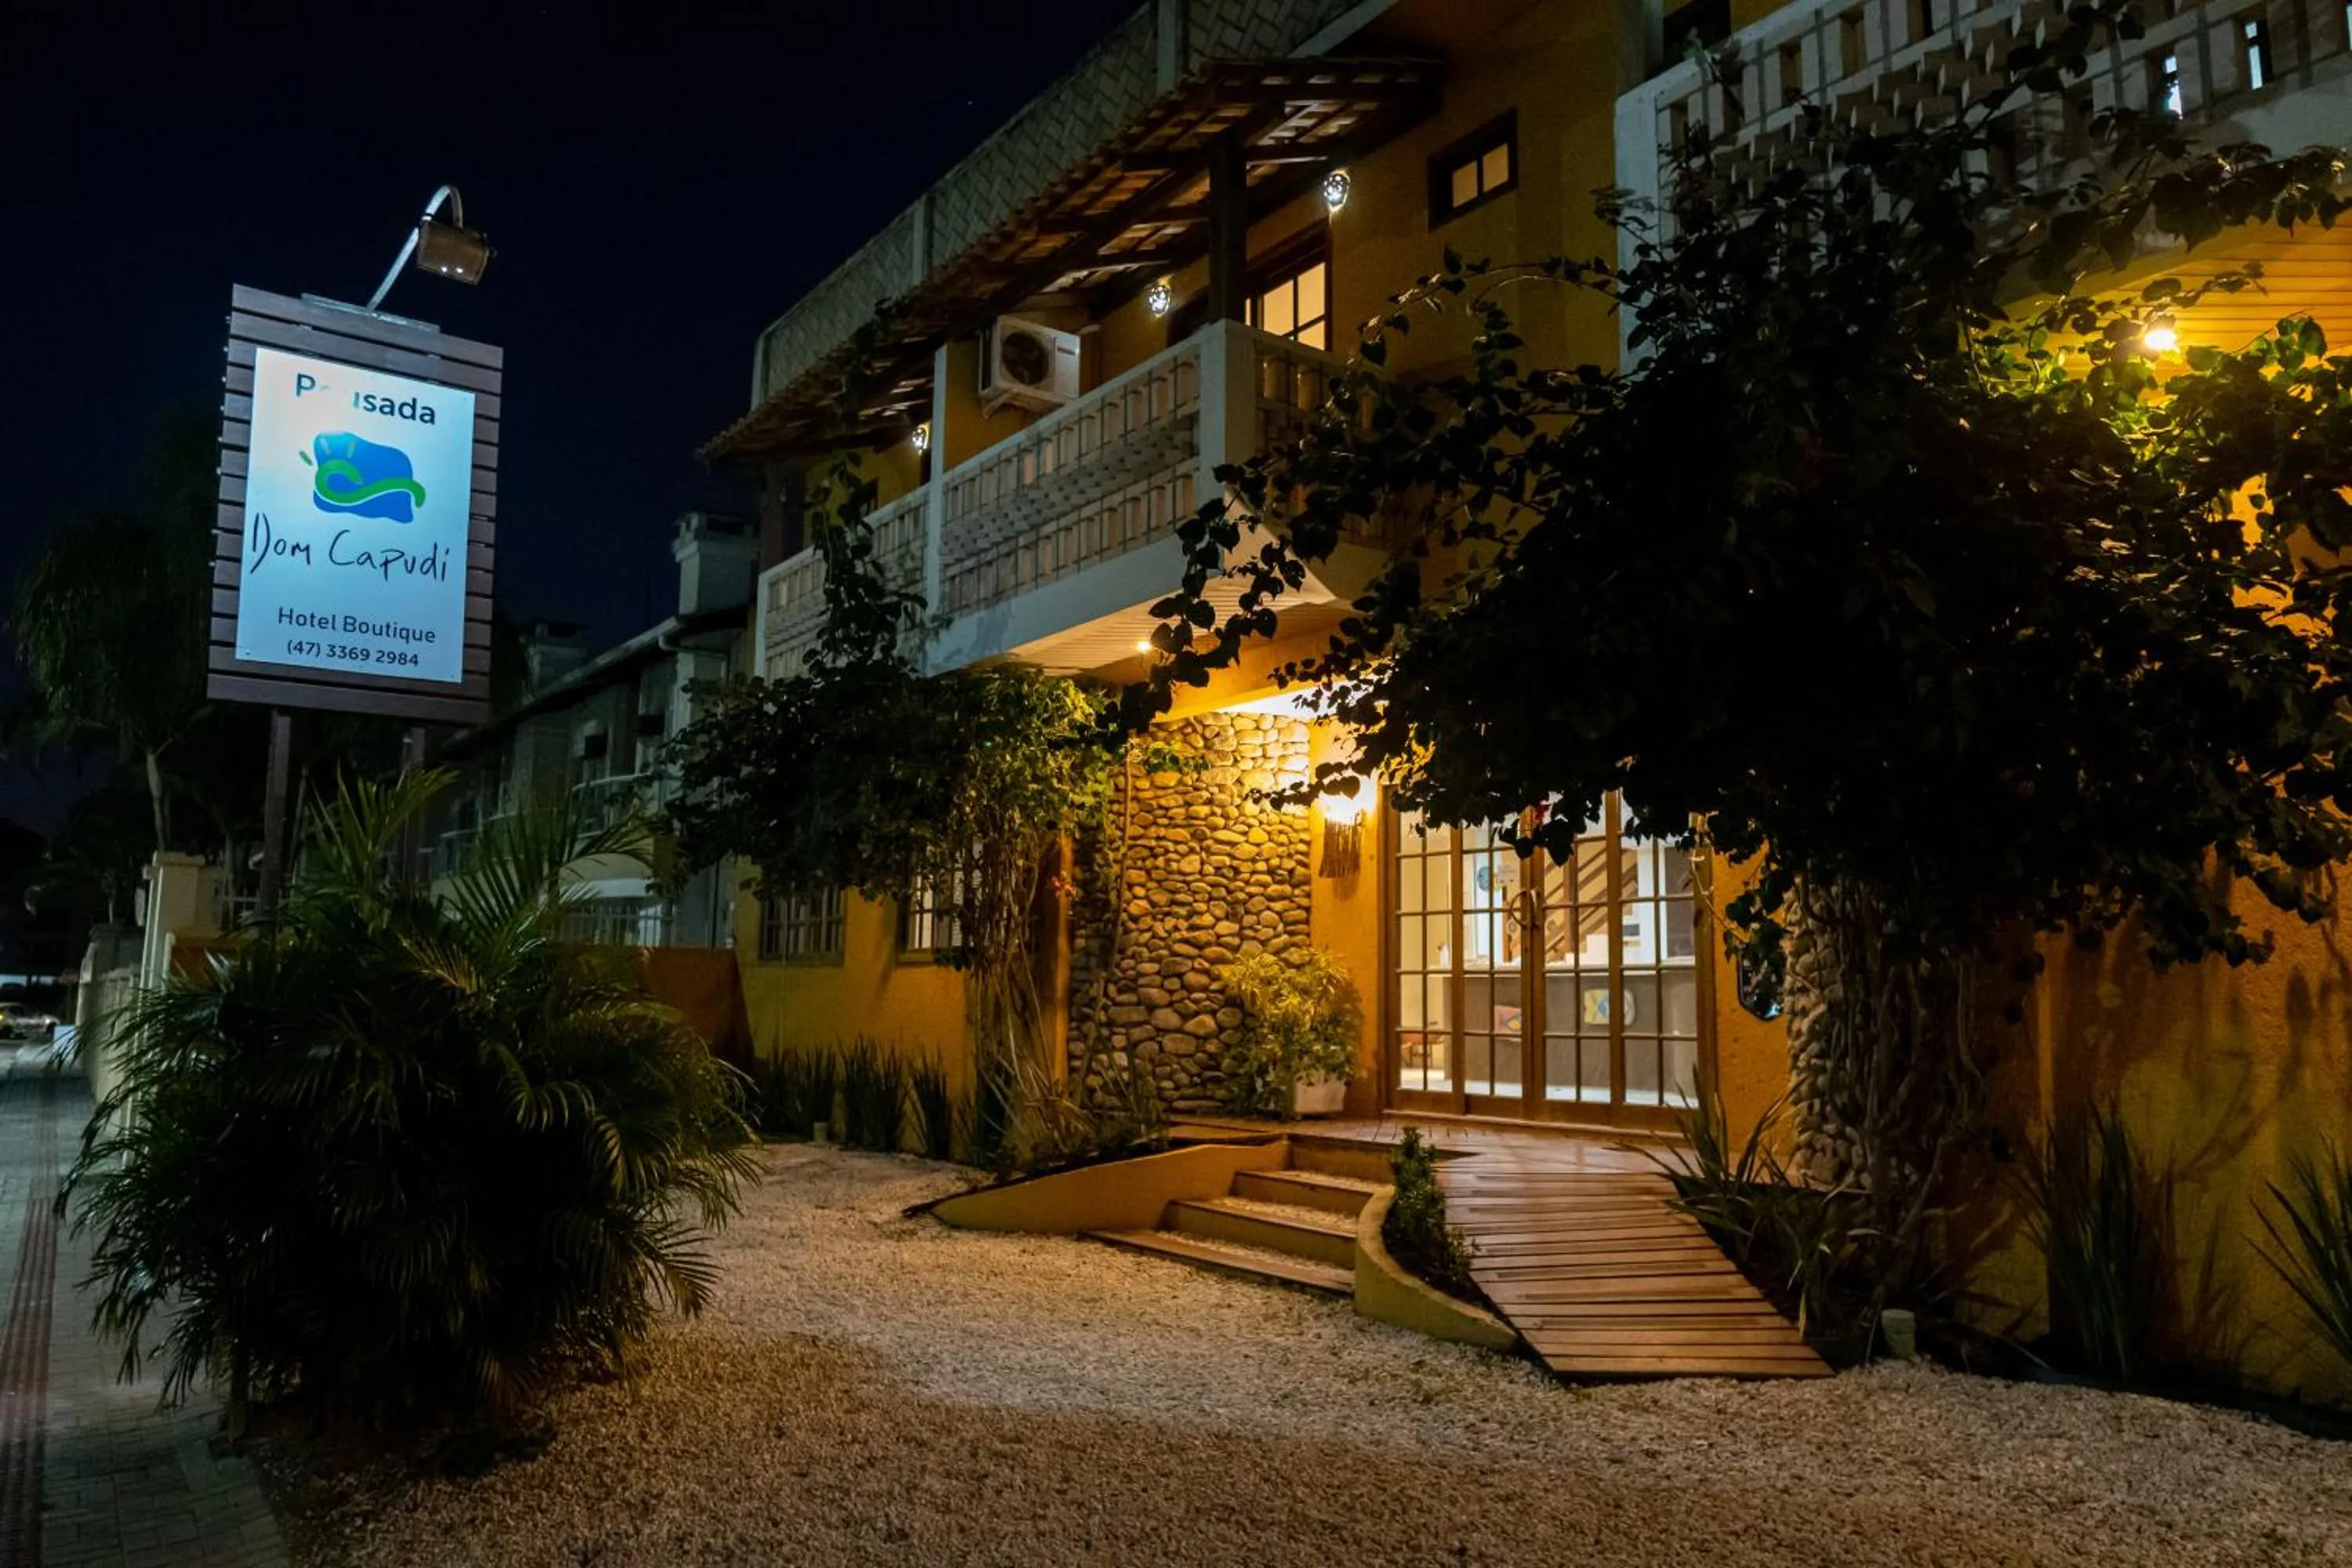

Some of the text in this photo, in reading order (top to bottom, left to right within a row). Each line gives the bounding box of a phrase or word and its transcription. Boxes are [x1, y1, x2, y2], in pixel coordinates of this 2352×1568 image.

[296, 372, 436, 426] Psada
[250, 512, 450, 582] Dom Capudi
[278, 606, 436, 645] Hotel Boutique
[287, 639, 419, 666] (47) 3369 2984
